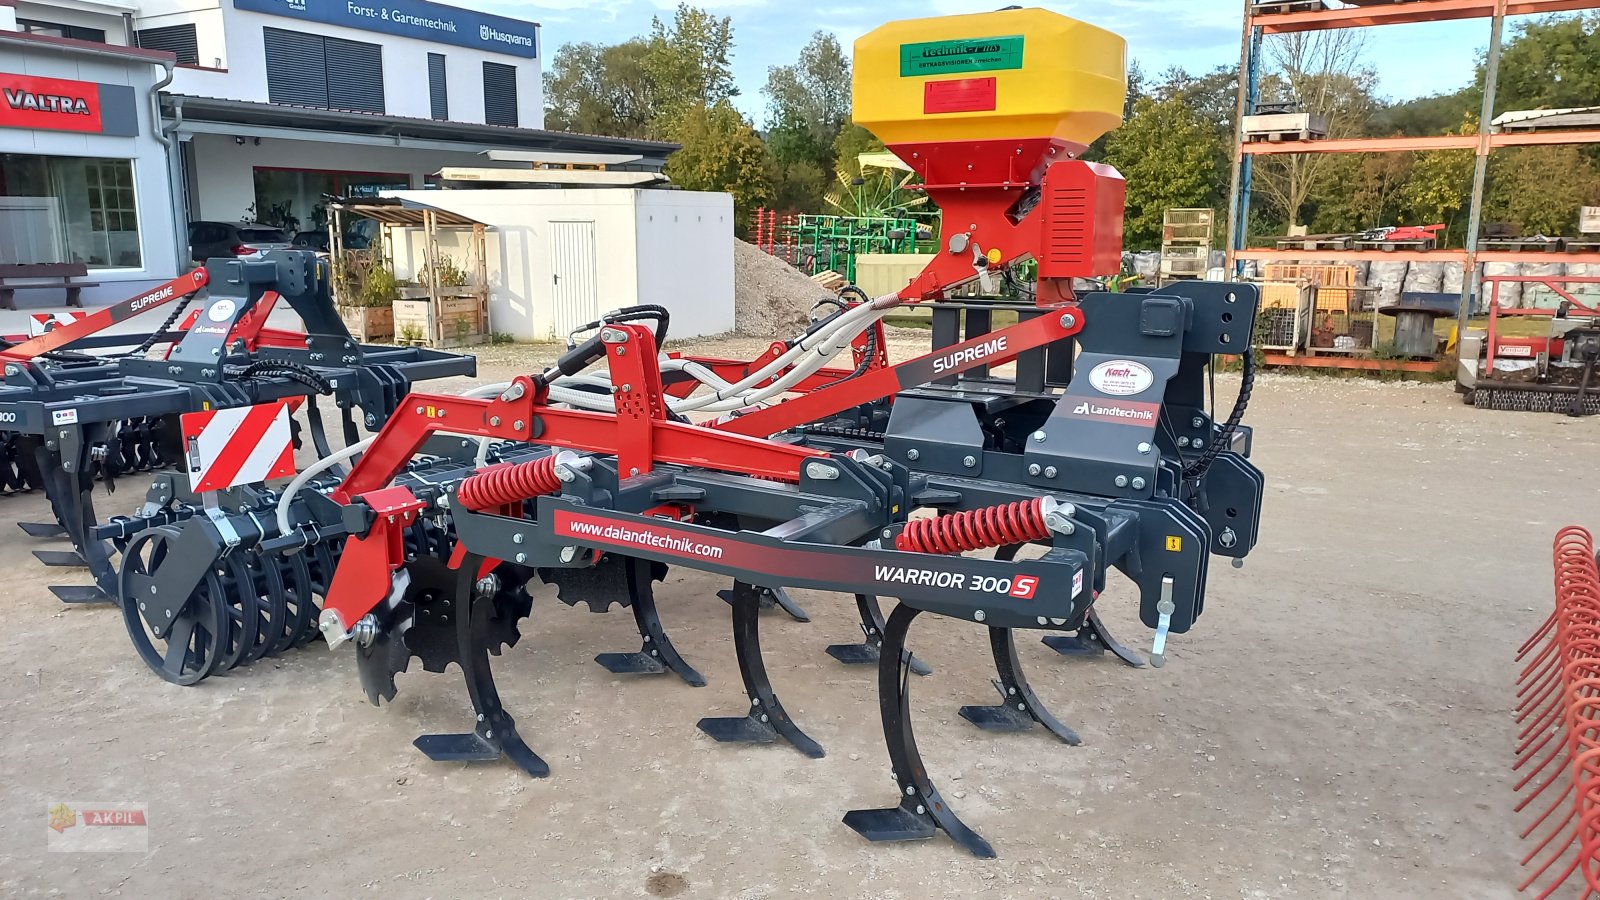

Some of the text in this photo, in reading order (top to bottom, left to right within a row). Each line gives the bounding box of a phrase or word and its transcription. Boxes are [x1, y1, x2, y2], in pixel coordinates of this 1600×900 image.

[347, 1, 457, 33] Forst- & Gartentechnik
[489, 28, 532, 47] Husqvarna
[2, 88, 90, 115] VALTRA
[131, 286, 173, 312] SUPREME
[933, 336, 1007, 373] SUPREME
[1091, 404, 1153, 420] Landtechnik
[570, 520, 723, 558] www.dalandtechnik.com
[875, 565, 965, 589] WARRIOR
